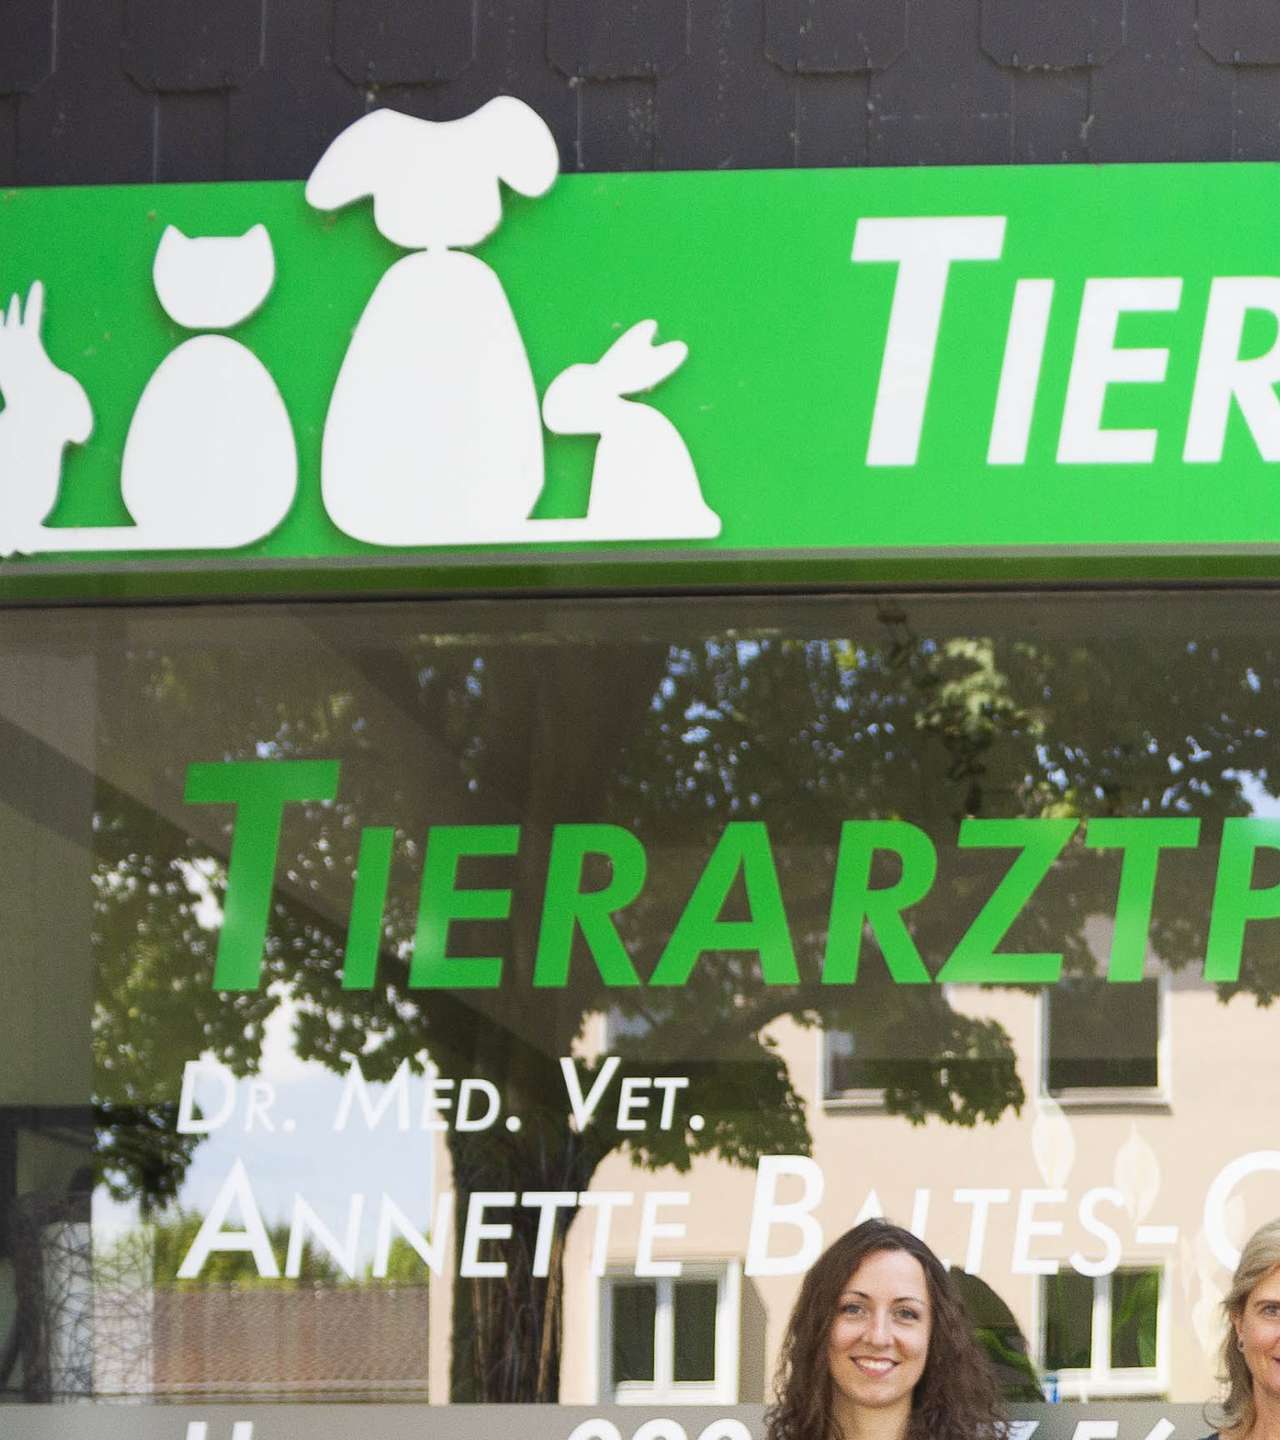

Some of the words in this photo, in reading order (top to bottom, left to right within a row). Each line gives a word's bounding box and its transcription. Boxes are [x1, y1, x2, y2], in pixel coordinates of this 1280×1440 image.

[176, 1059, 297, 1134] DR.
[333, 1055, 523, 1133] MED.
[560, 1055, 706, 1133] VET.
[176, 1157, 693, 1279] ANNETTE
